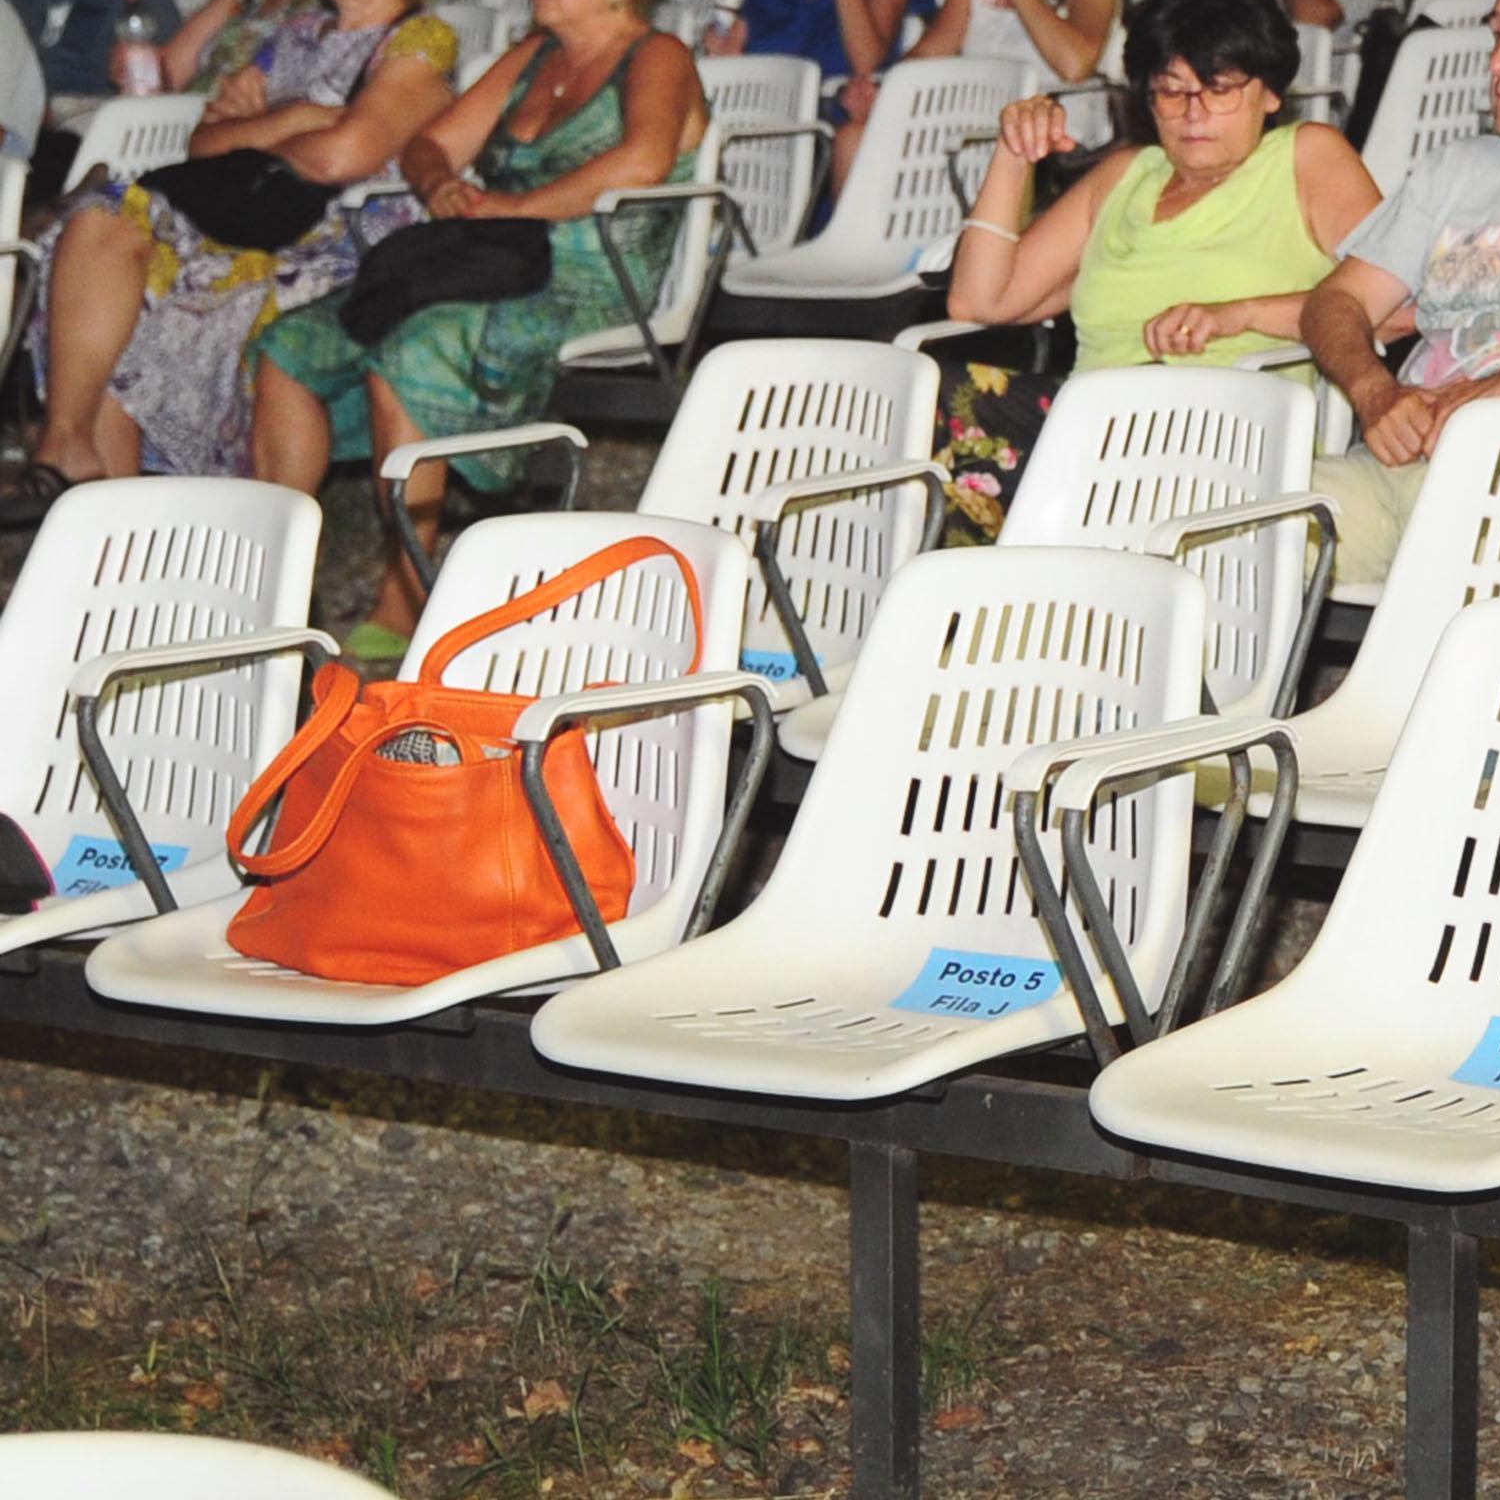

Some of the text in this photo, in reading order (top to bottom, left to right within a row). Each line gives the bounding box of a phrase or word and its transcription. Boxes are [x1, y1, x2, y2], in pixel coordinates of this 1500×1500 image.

[939, 962, 1044, 990] Posto 5
[930, 994, 1009, 1015] Fila J
